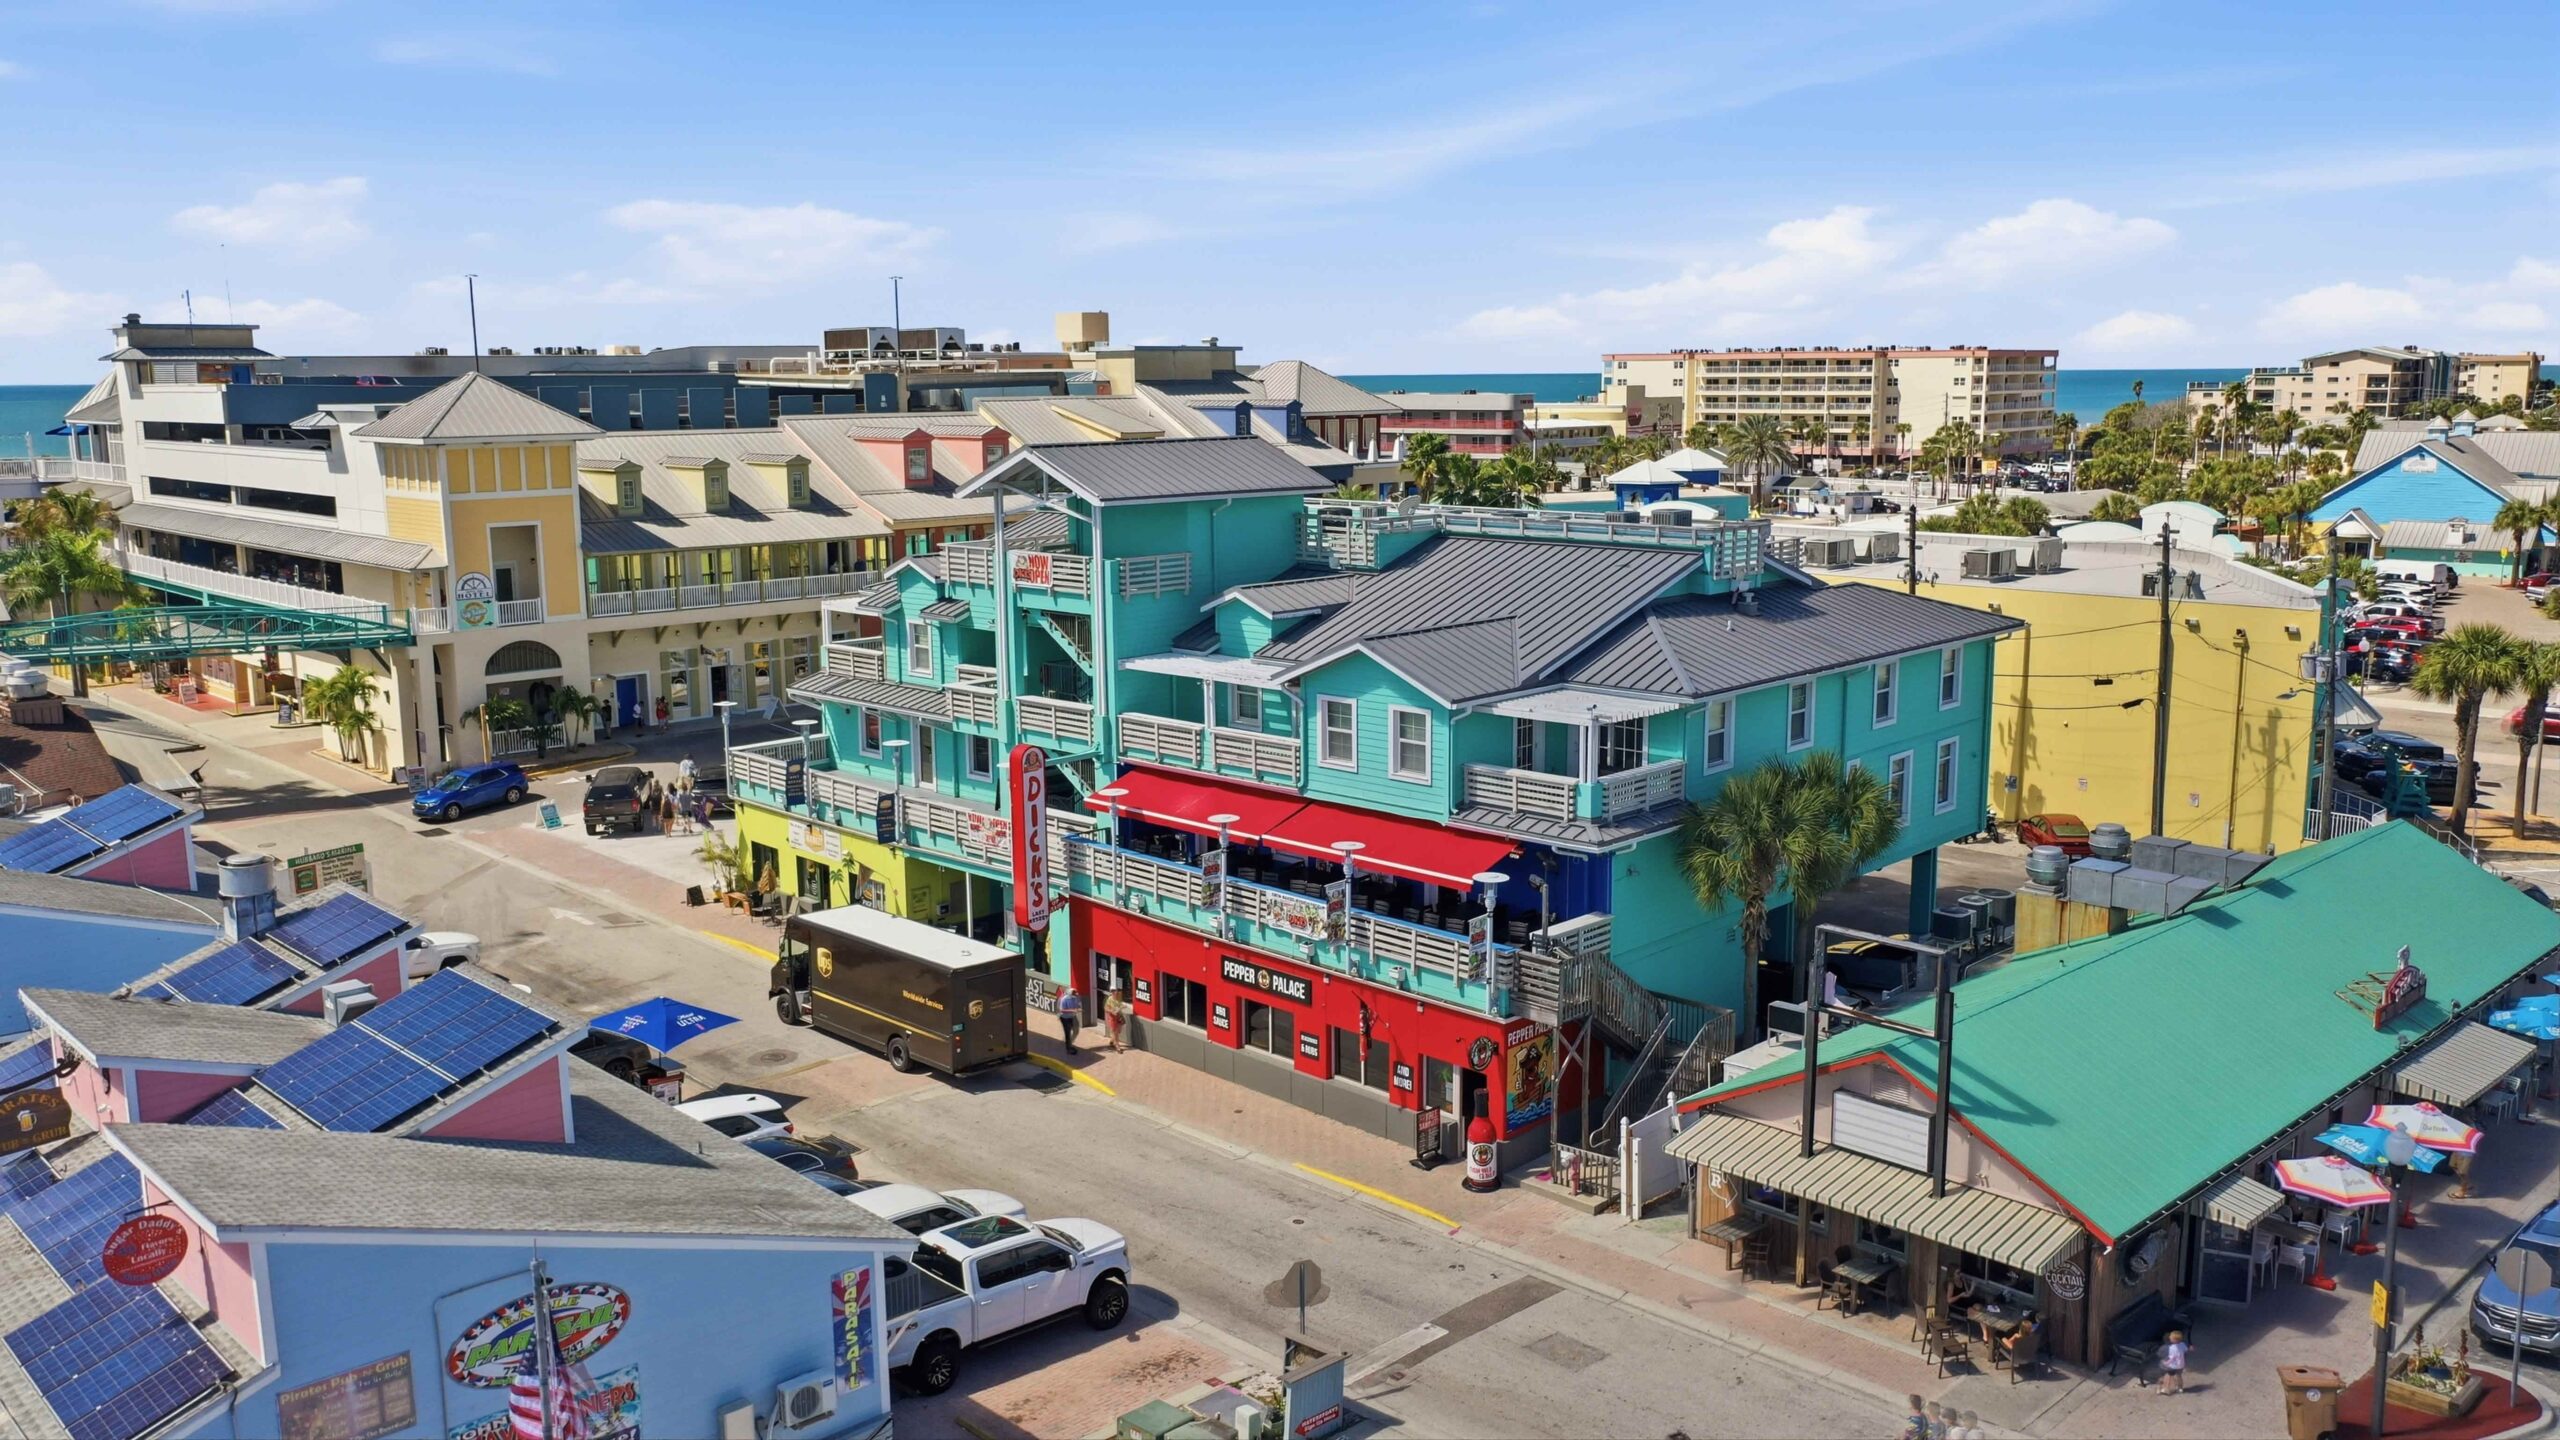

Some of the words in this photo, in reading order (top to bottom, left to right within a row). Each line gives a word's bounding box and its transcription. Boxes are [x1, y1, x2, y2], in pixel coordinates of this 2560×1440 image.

[1028, 554, 1049, 569] NOW
[1031, 568, 1050, 585] OPEN
[457, 591, 490, 599] HOTEL
[1027, 776, 1043, 908] DICK'S
[331, 845, 356, 857] MARINA
[1137, 979, 1148, 991] HOT
[1224, 960, 1256, 985] PEPPER
[1272, 974, 1306, 999] PALACE
[902, 989, 926, 1004] Worldwide
[925, 997, 944, 1011] Services
[1135, 989, 1151, 1003] SAUCE
[1215, 1005, 1227, 1018] BBQ
[676, 1014, 706, 1027] ULTRA
[1213, 1015, 1229, 1030] SAUCE
[1507, 1024, 1534, 1048] PEPPER
[1397, 1064, 1410, 1078] AND
[1393, 1075, 1413, 1092] MORE!
[2338, 1134, 2369, 1152] KONA
[130, 1247, 166, 1264] Locally
[2045, 1272, 2084, 1287] COCKTAIL
[502, 1296, 581, 1328] EALE
[464, 1302, 616, 1370] PARSAIL
[843, 1272, 860, 1389] PARASAIL
[280, 1382, 328, 1405] Pirates
[331, 1373, 358, 1390] Pub
[375, 1355, 409, 1374] Grub
